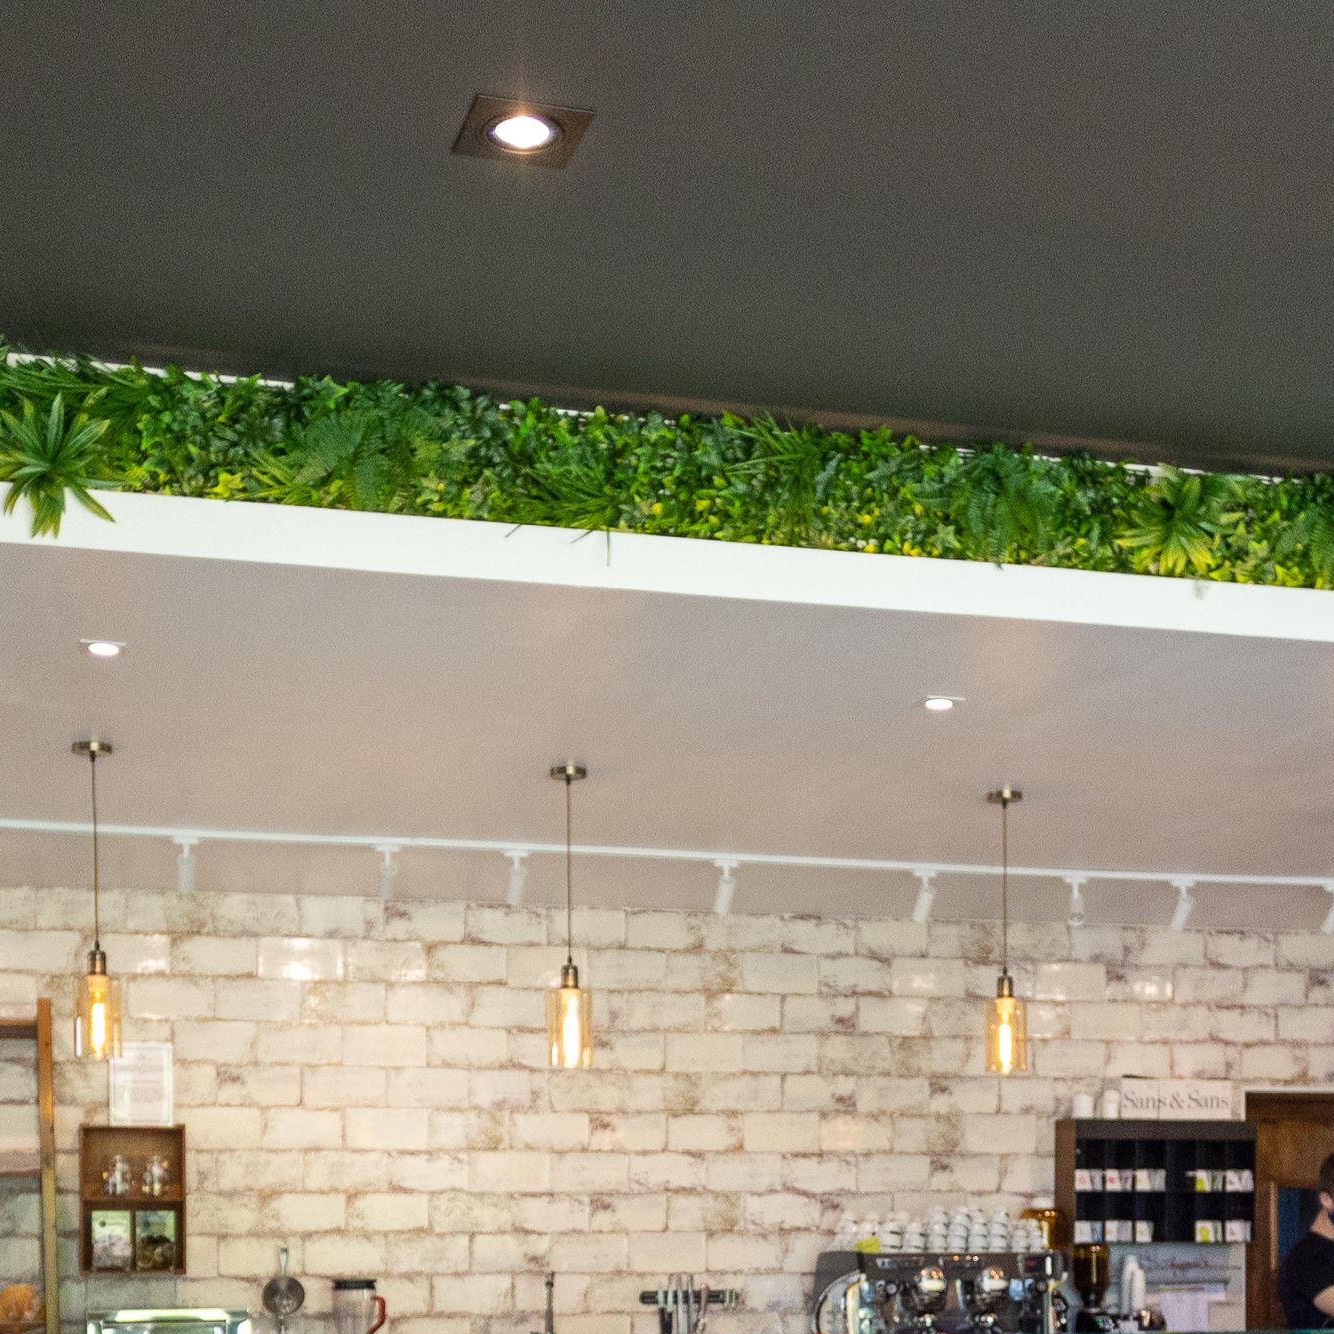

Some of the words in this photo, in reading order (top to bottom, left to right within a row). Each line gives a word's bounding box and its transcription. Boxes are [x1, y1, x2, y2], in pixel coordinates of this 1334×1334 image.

[1123, 1089, 1167, 1110] Sans
[1169, 1090, 1185, 1110] &
[1187, 1088, 1229, 1110] Sans
